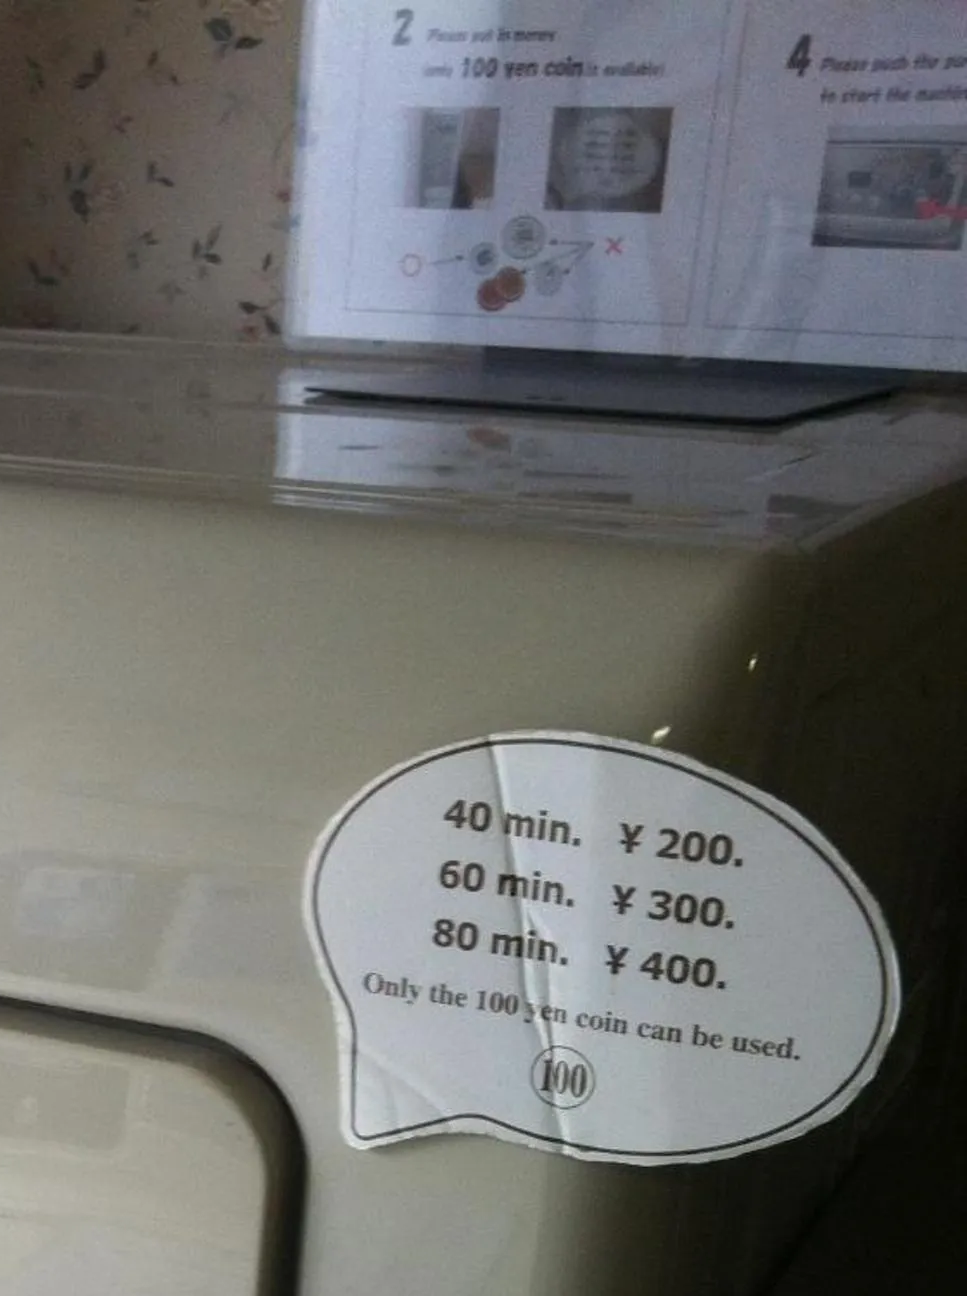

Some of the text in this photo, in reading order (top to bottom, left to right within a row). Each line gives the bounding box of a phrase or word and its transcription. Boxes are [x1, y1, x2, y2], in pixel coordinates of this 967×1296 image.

[391, 8, 414, 46] 2
[461, 57, 498, 78] 100
[504, 60, 539, 79] yen
[543, 55, 584, 77] coin
[786, 34, 811, 77] 4
[913, 53, 939, 71] the
[443, 799, 492, 833] 40
[501, 808, 582, 847] min.
[655, 827, 744, 868] 200.
[439, 860, 485, 893] 60
[497, 870, 575, 908] min.
[647, 889, 735, 930] 300.
[432, 918, 479, 953] 80
[491, 929, 569, 967] min.
[639, 950, 727, 990] 400.
[363, 971, 421, 1006] Only
[429, 983, 468, 1009] the
[475, 989, 519, 1017] 100
[575, 1007, 629, 1037] coin
[636, 1019, 683, 1044] can
[691, 1022, 724, 1051] be
[731, 1034, 801, 1063] used.
[539, 1058, 589, 1100] 100
